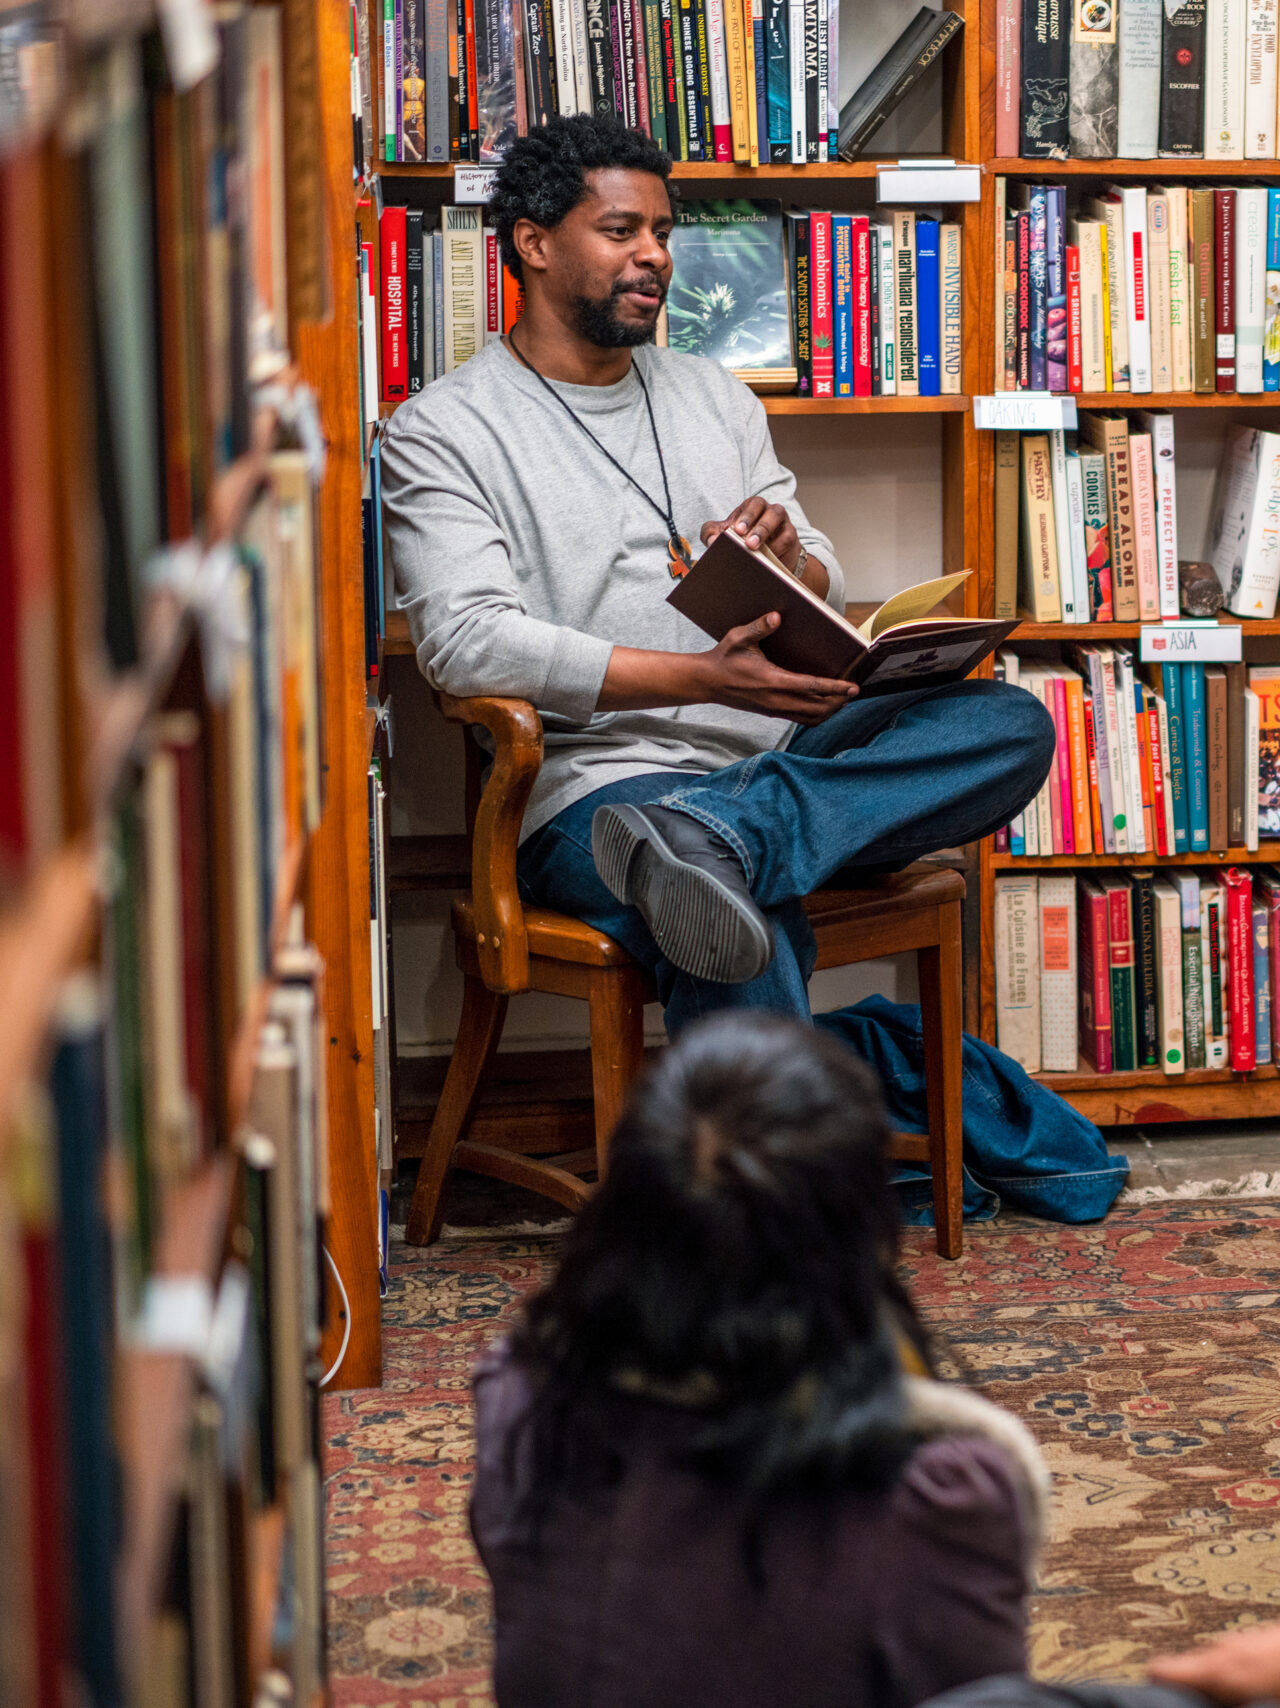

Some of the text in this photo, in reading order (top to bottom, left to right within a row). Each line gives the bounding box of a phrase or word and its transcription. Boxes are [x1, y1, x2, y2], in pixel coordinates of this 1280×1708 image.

[664, 20, 672, 37] Open
[665, 38, 673, 58] Water
[683, 16, 698, 138] CHINESE QIGONG ESSENTIALS
[697, 14, 709, 96] UNDERWATER ODYSSEY
[668, 79, 676, 103] Manual
[447, 210, 478, 230] SHILTS
[679, 212, 768, 223] The Secret Garden
[452, 240, 474, 261] AND
[488, 238, 496, 260] THE
[1020, 216, 1029, 270] CASSEROLE
[452, 264, 474, 286] THE
[816, 222, 830, 318] cannabinomics
[1170, 250, 1182, 326] fresh fast
[387, 276, 402, 331] HOSPITAL
[452, 290, 475, 318] BAND
[489, 287, 497, 329] MARKET
[858, 232, 870, 366] Respiratory Therapy Pharmacology
[898, 250, 918, 382] marihuana reconsidered
[944, 230, 960, 375] WARNER INVISIBLE HAND
[1020, 271, 1029, 328] COOKBOOK
[1072, 298, 1081, 335] SRIRACHA
[1020, 332, 1028, 349] PAUL
[1072, 337, 1080, 366] COOKBOOK
[1032, 450, 1046, 501] PASTRY
[1086, 470, 1099, 516] COOKIES
[1116, 450, 1134, 588] BREAD ALONE
[1162, 488, 1175, 592] PERFECT FINISH
[1170, 631, 1198, 650] ASIA
[1149, 714, 1162, 780] Indian fast food
[1192, 708, 1202, 756] Tradewinds
[1170, 716, 1184, 800] Curries & Bugles
[1194, 769, 1204, 810] Coconuts
[1188, 946, 1200, 1048] Essential Nourishment
